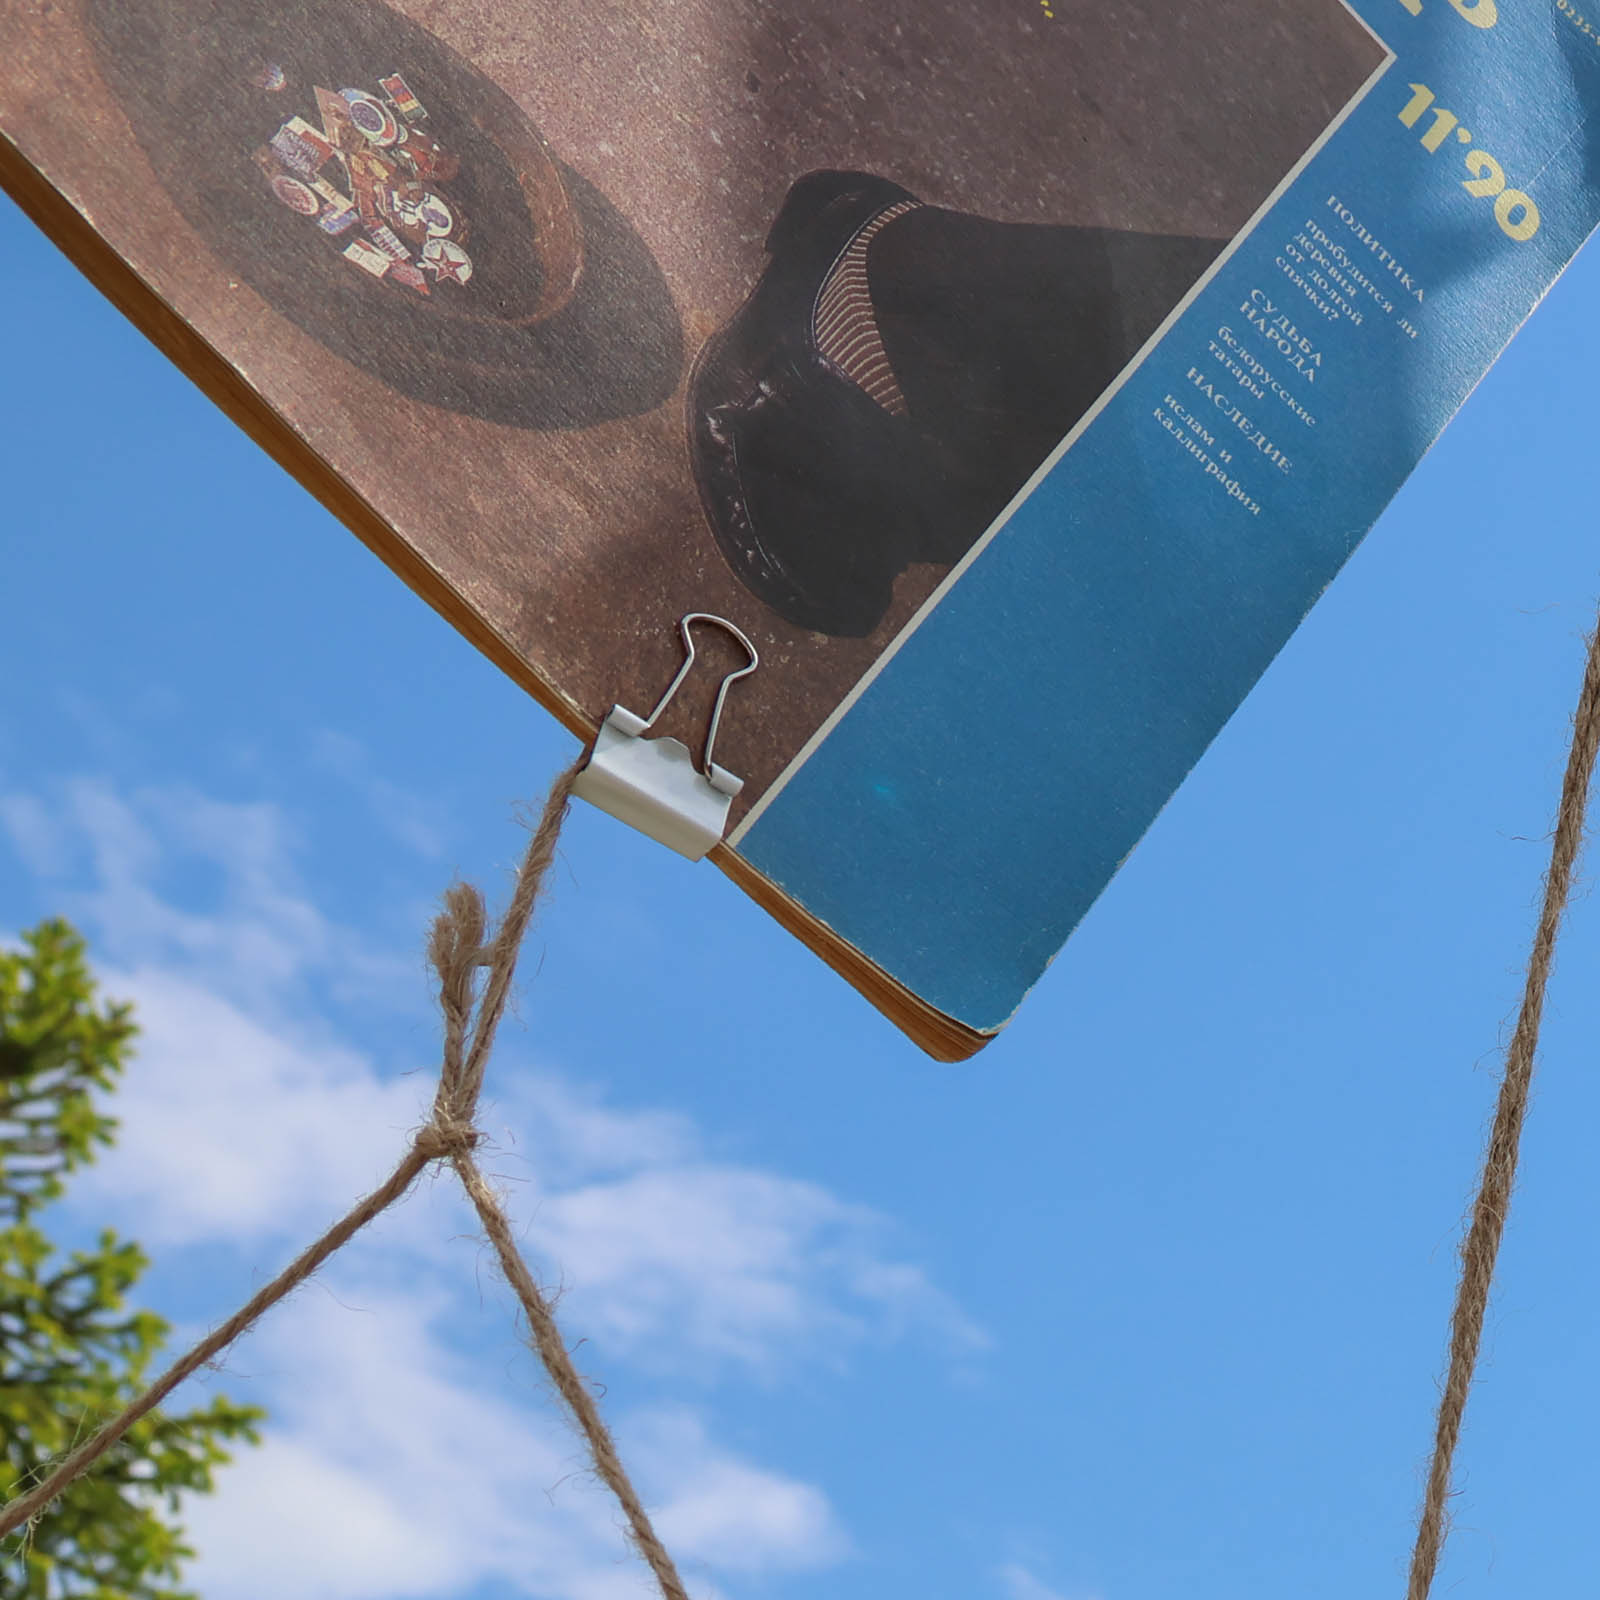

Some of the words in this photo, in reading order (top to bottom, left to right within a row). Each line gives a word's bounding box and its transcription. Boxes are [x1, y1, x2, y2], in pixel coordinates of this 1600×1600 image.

[1275, 256, 1340, 321] спячки?
[1285, 244, 1304, 263] от
[1308, 269, 1363, 326] долгой
[1293, 232, 1358, 297] деревня
[1305, 219, 1393, 313] пробудится
[1397, 318, 1418, 339] ли
[1327, 195, 1425, 303] ПОЛИТИКА
[1239, 301, 1316, 384] НАРОДА
[1251, 289, 1323, 367] СУДЬБА
[1208, 340, 1265, 400] татары
[1217, 325, 1317, 427] белорусские
[1164, 394, 1216, 447] ислам
[1219, 449, 1233, 464] и
[1186, 366, 1293, 474] НАСЛЕДИЕ
[1153, 407, 1262, 516] каллиграфия
